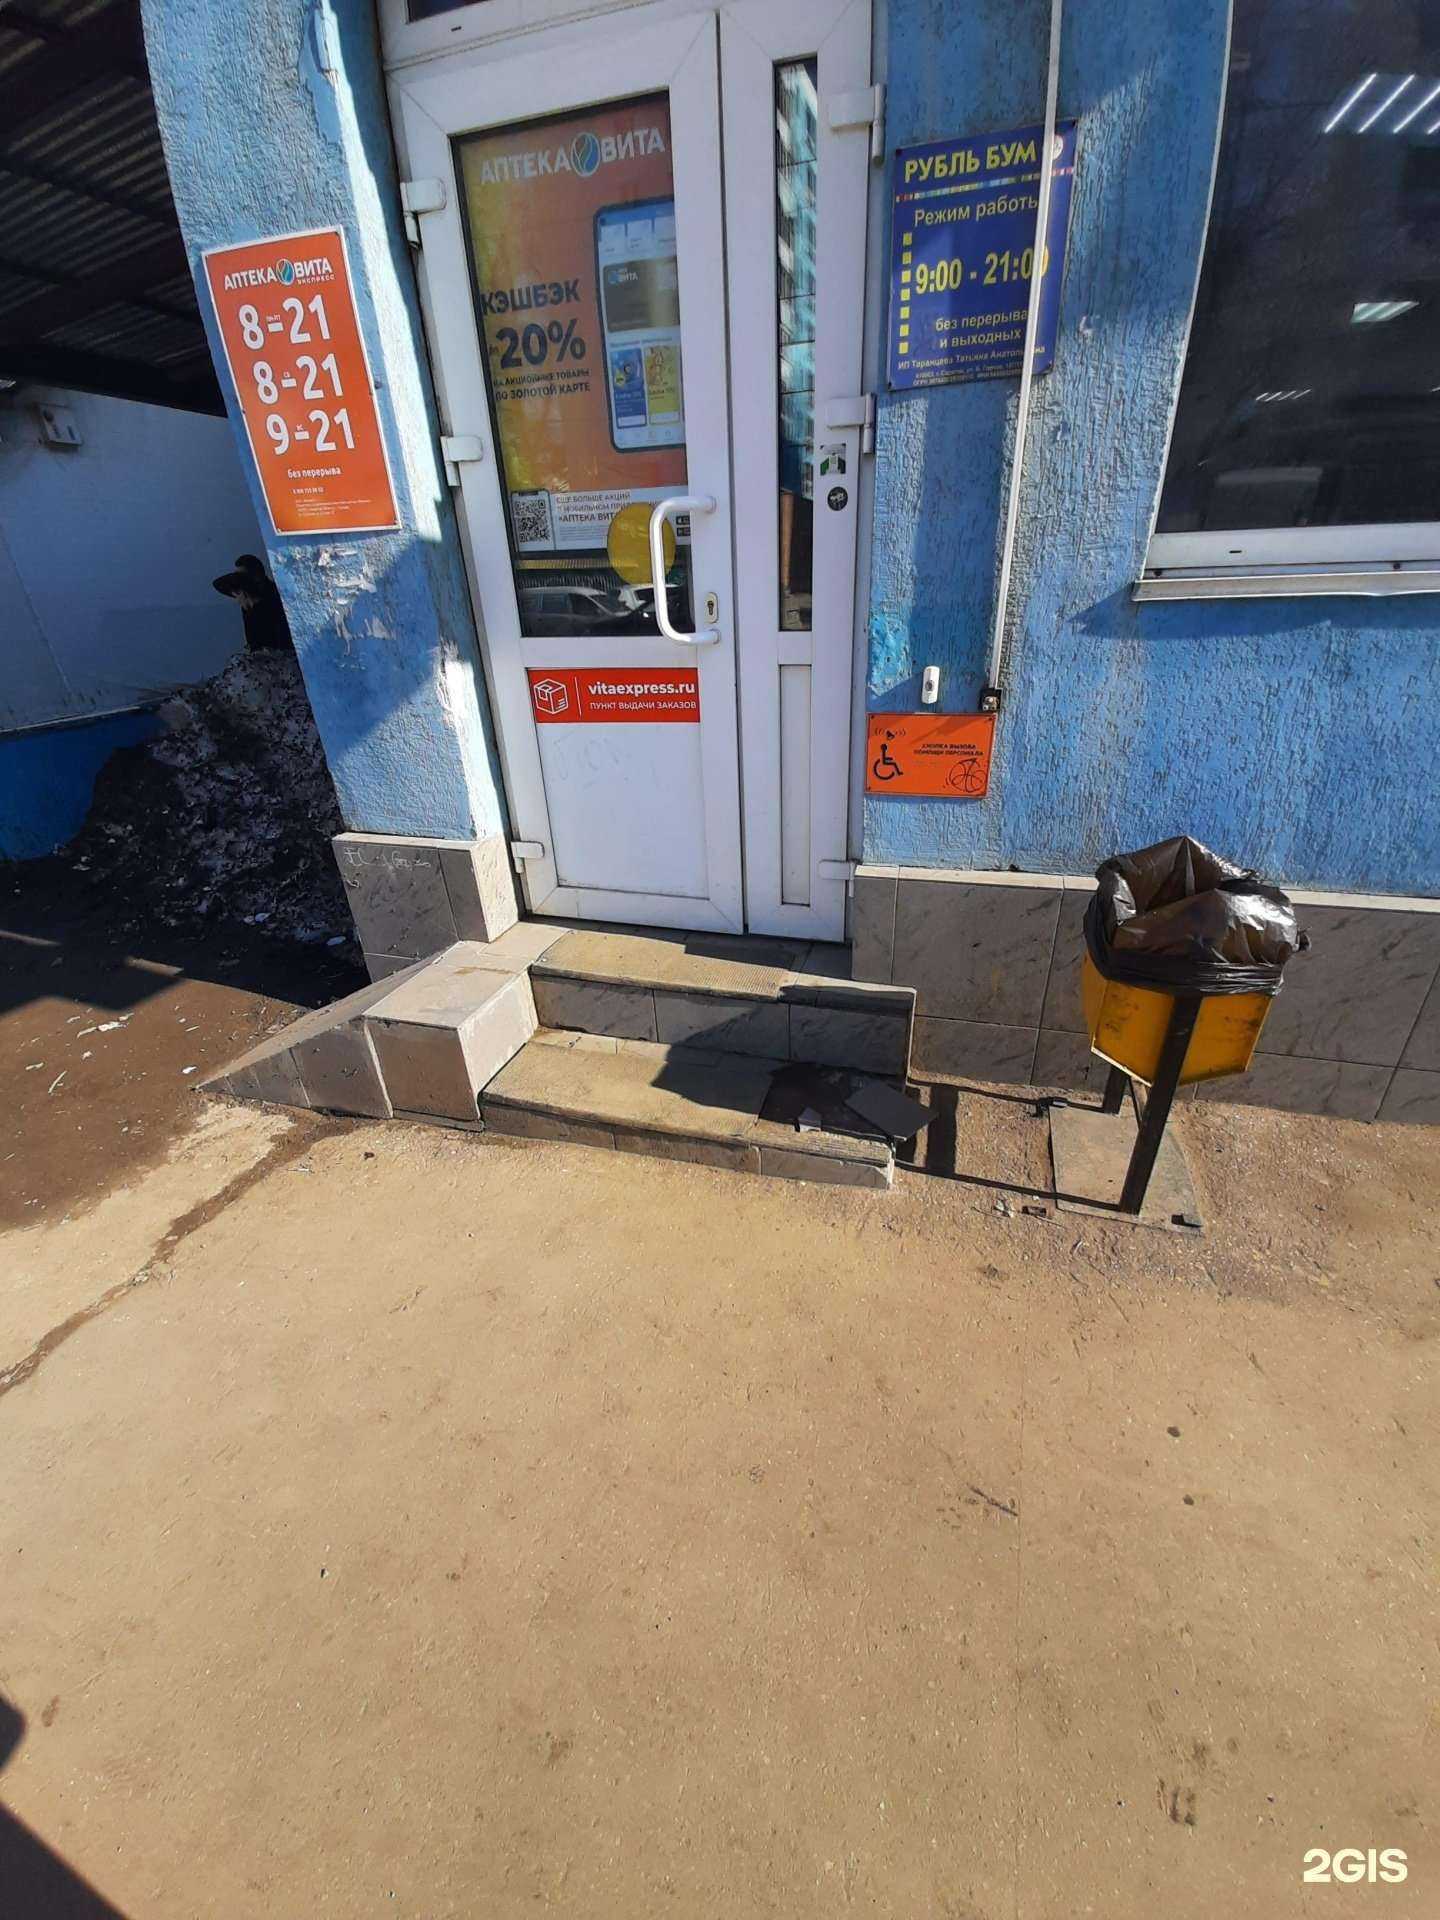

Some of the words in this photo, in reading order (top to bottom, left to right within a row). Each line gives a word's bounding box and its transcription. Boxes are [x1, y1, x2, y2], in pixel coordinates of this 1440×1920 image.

[481, 151, 571, 184] АПТЕКА
[601, 128, 665, 164] ВИТА
[904, 149, 980, 183] РУБЛЬ
[986, 139, 1037, 170] БУМ
[914, 204, 970, 227] Режим
[224, 266, 278, 291] АПТЕКА
[293, 257, 333, 278] ВИТА
[915, 258, 962, 294] 9:00
[481, 278, 580, 315] КЭШБЭК
[936, 318, 957, 332] без
[961, 310, 1029, 328] перерыва
[496, 319, 586, 369] 20%
[952, 329, 1021, 347] выходных
[511, 386, 556, 399] ЗОЛОТОЙ
[560, 382, 590, 395] КАРТЕ
[287, 468, 301, 478] без
[303, 467, 341, 478] перерыва
[598, 512, 615, 521] ВИТ
[588, 682, 695, 696] vitaexpress.ru
[590, 702, 616, 710] ПУНКТ
[619, 702, 654, 711] ВЫДАЧИ
[656, 701, 696, 709] ЗАКАЗОВ
